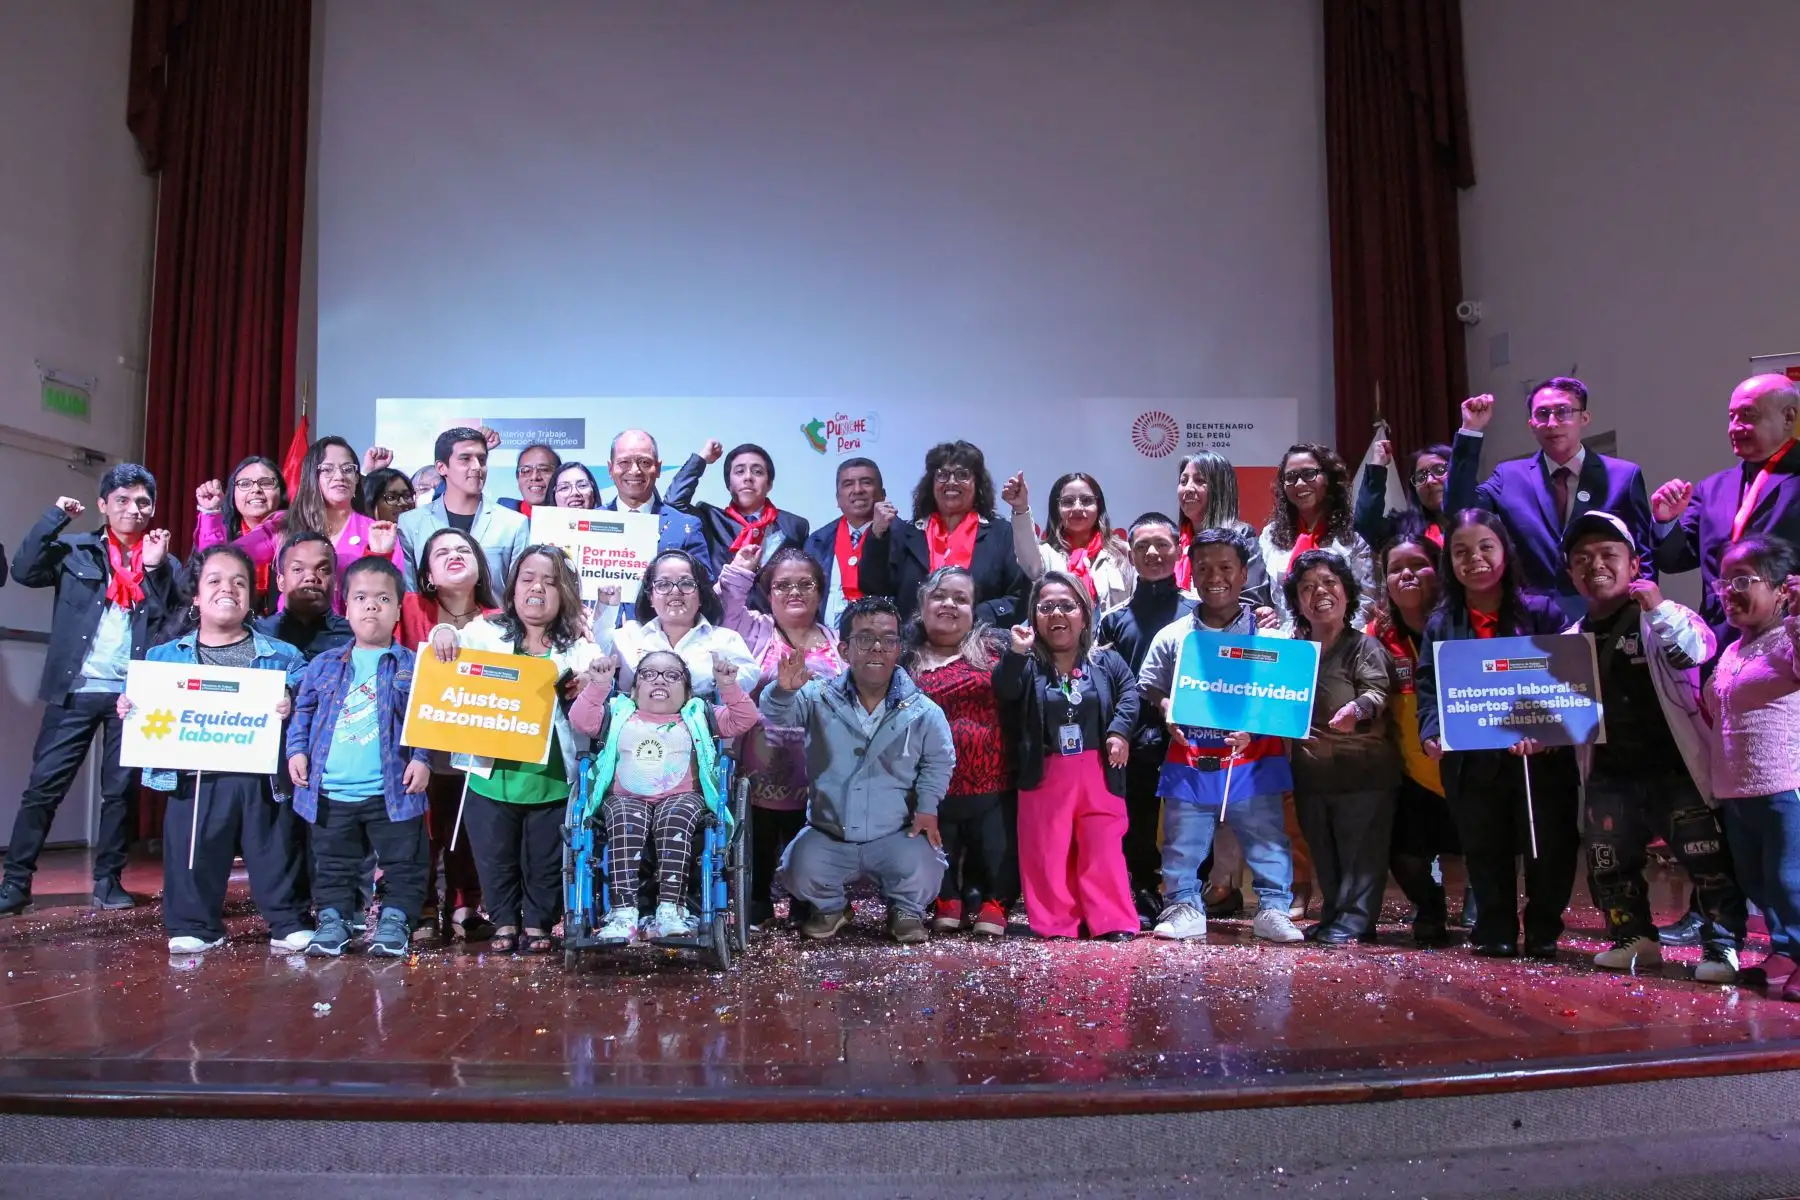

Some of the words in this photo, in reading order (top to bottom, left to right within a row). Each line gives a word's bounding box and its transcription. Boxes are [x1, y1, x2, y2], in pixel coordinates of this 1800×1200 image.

[835, 412, 848, 421] Con
[526, 430, 537, 438] de
[538, 430, 567, 440] Trabajo
[548, 438, 578, 447] Empleo
[1207, 430, 1231, 439] PERÚ
[583, 546, 606, 557] Por
[608, 548, 636, 559] más
[582, 556, 649, 569] Empresas
[1179, 675, 1309, 702] Productividad
[1448, 685, 1515, 699] Entornos
[1517, 682, 1588, 696] laborales
[441, 687, 521, 712] Ajustes
[1446, 699, 1513, 714] abiertos,
[1515, 695, 1592, 710] accesibles
[180, 709, 269, 728] Equidad
[417, 703, 541, 736] Razonables
[1478, 718, 1487, 727] e
[1488, 712, 1563, 727] inclusivos
[179, 727, 255, 744] laboral
